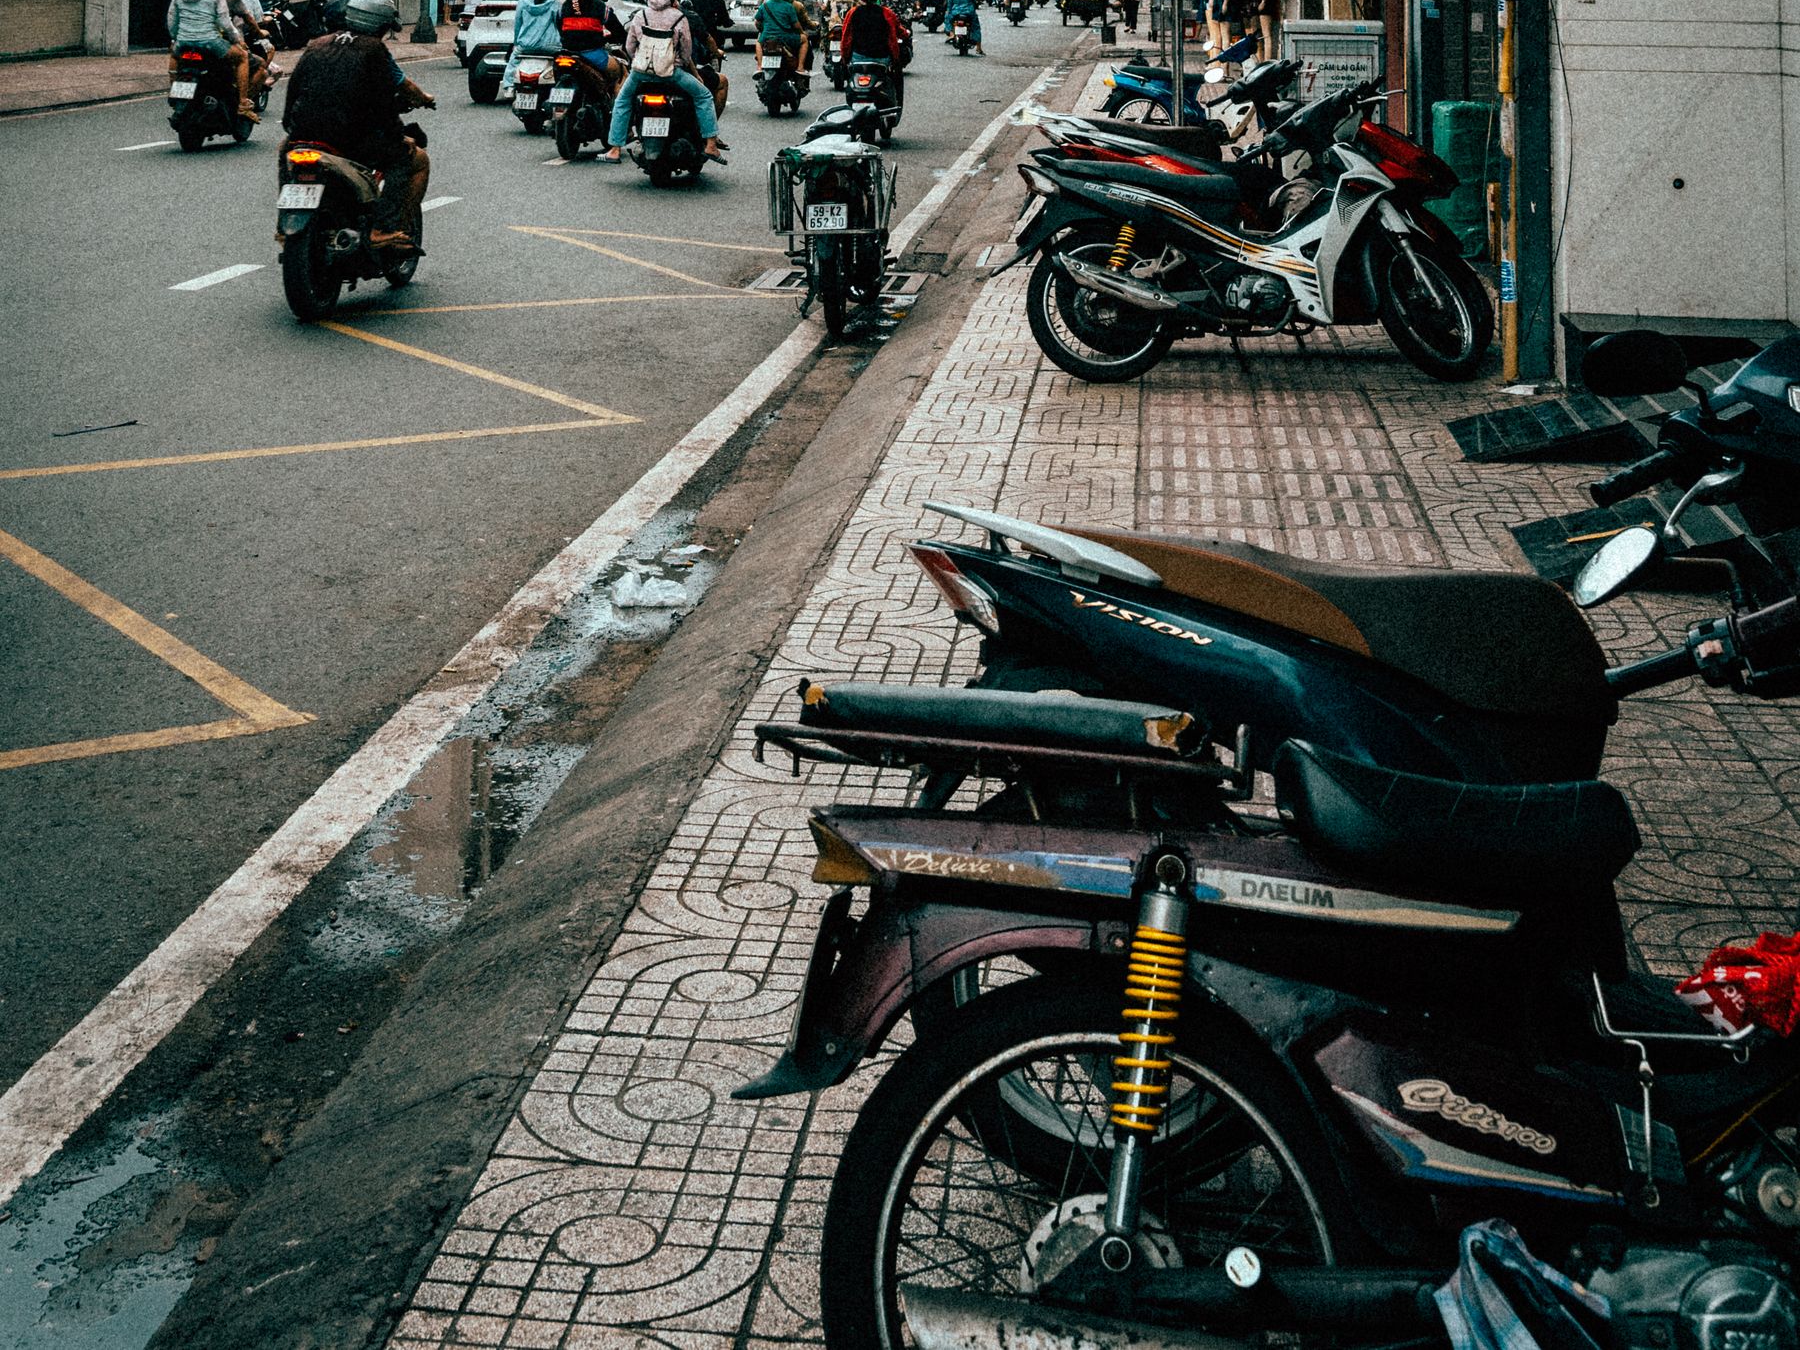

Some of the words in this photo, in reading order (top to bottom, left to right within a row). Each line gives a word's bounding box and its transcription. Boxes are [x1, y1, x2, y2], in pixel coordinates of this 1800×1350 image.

[1319, 61, 1335, 71] CẤM
[812, 205, 842, 217] 59-K2
[1069, 590, 1214, 645] VISION
[903, 851, 993, 876] Deluxe
[1241, 878, 1335, 909] DAELIM
